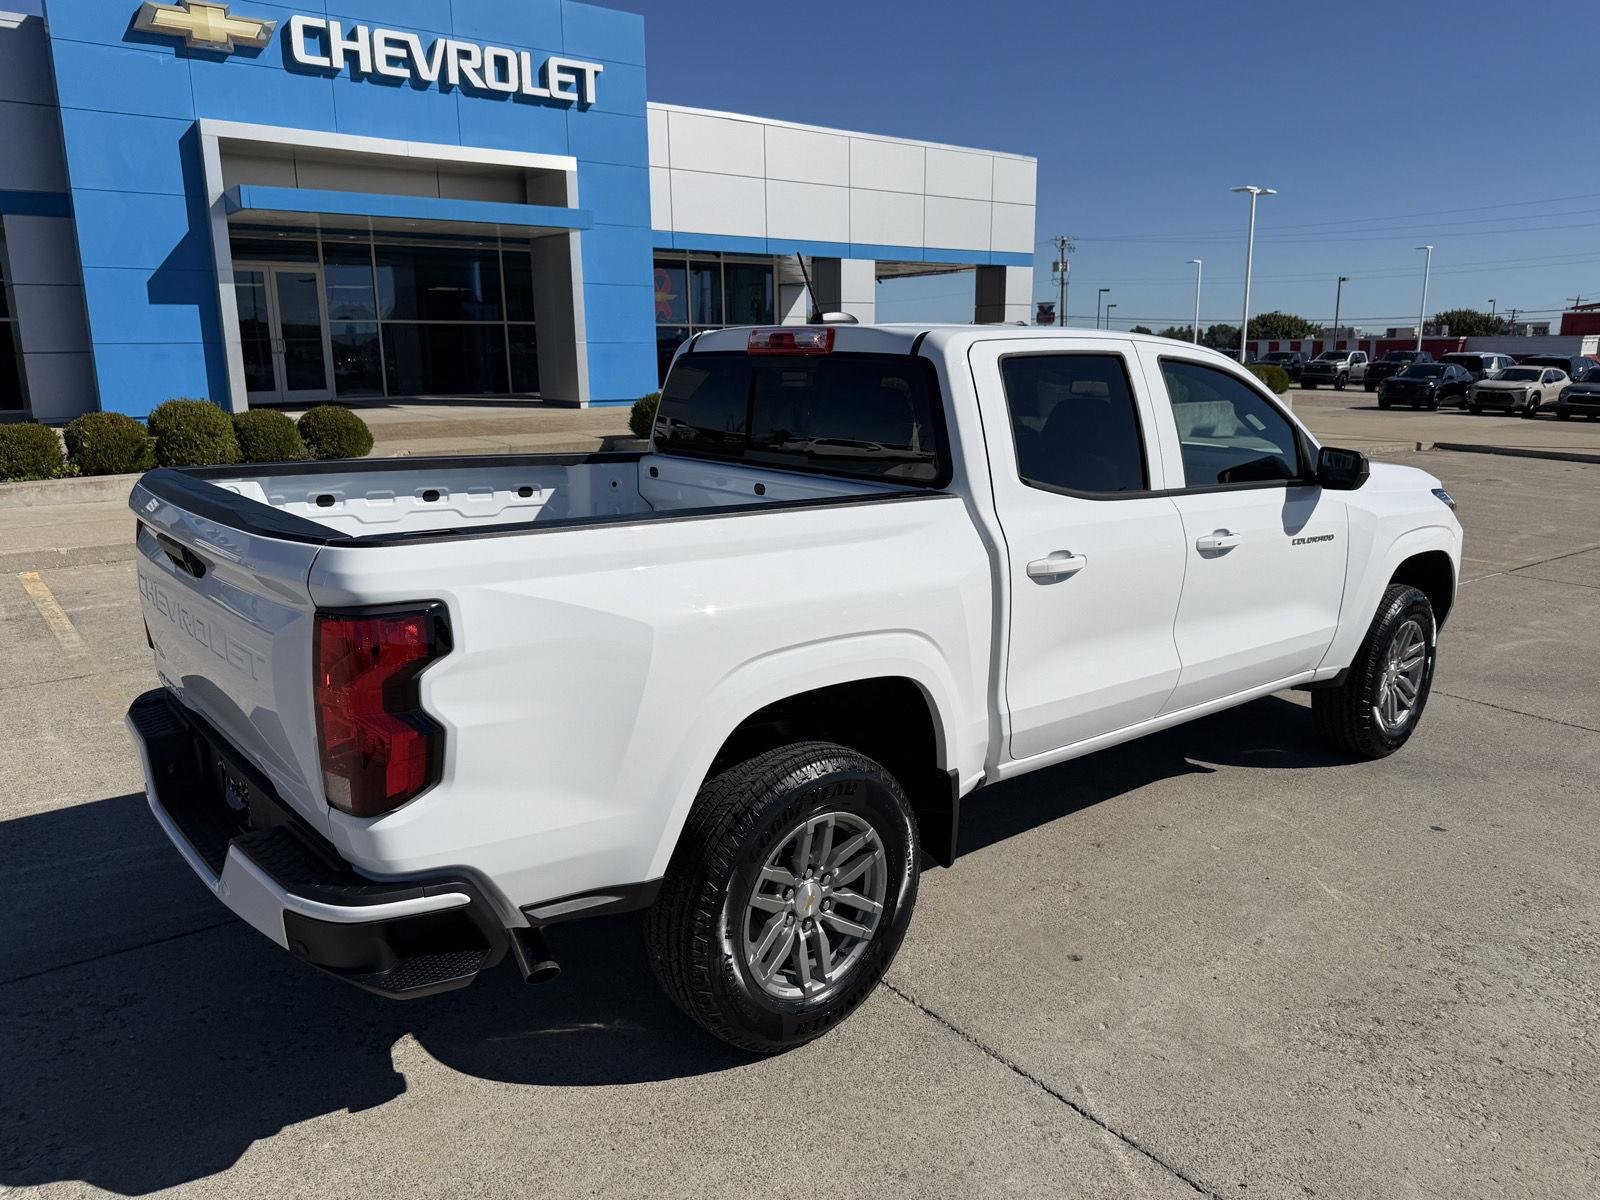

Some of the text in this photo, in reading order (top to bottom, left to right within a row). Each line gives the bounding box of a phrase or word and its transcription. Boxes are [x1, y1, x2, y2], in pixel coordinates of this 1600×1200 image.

[290, 15, 604, 104] CHEVROLET
[1291, 534, 1335, 546] COLORADO
[139, 574, 267, 683] CHEVROLET
